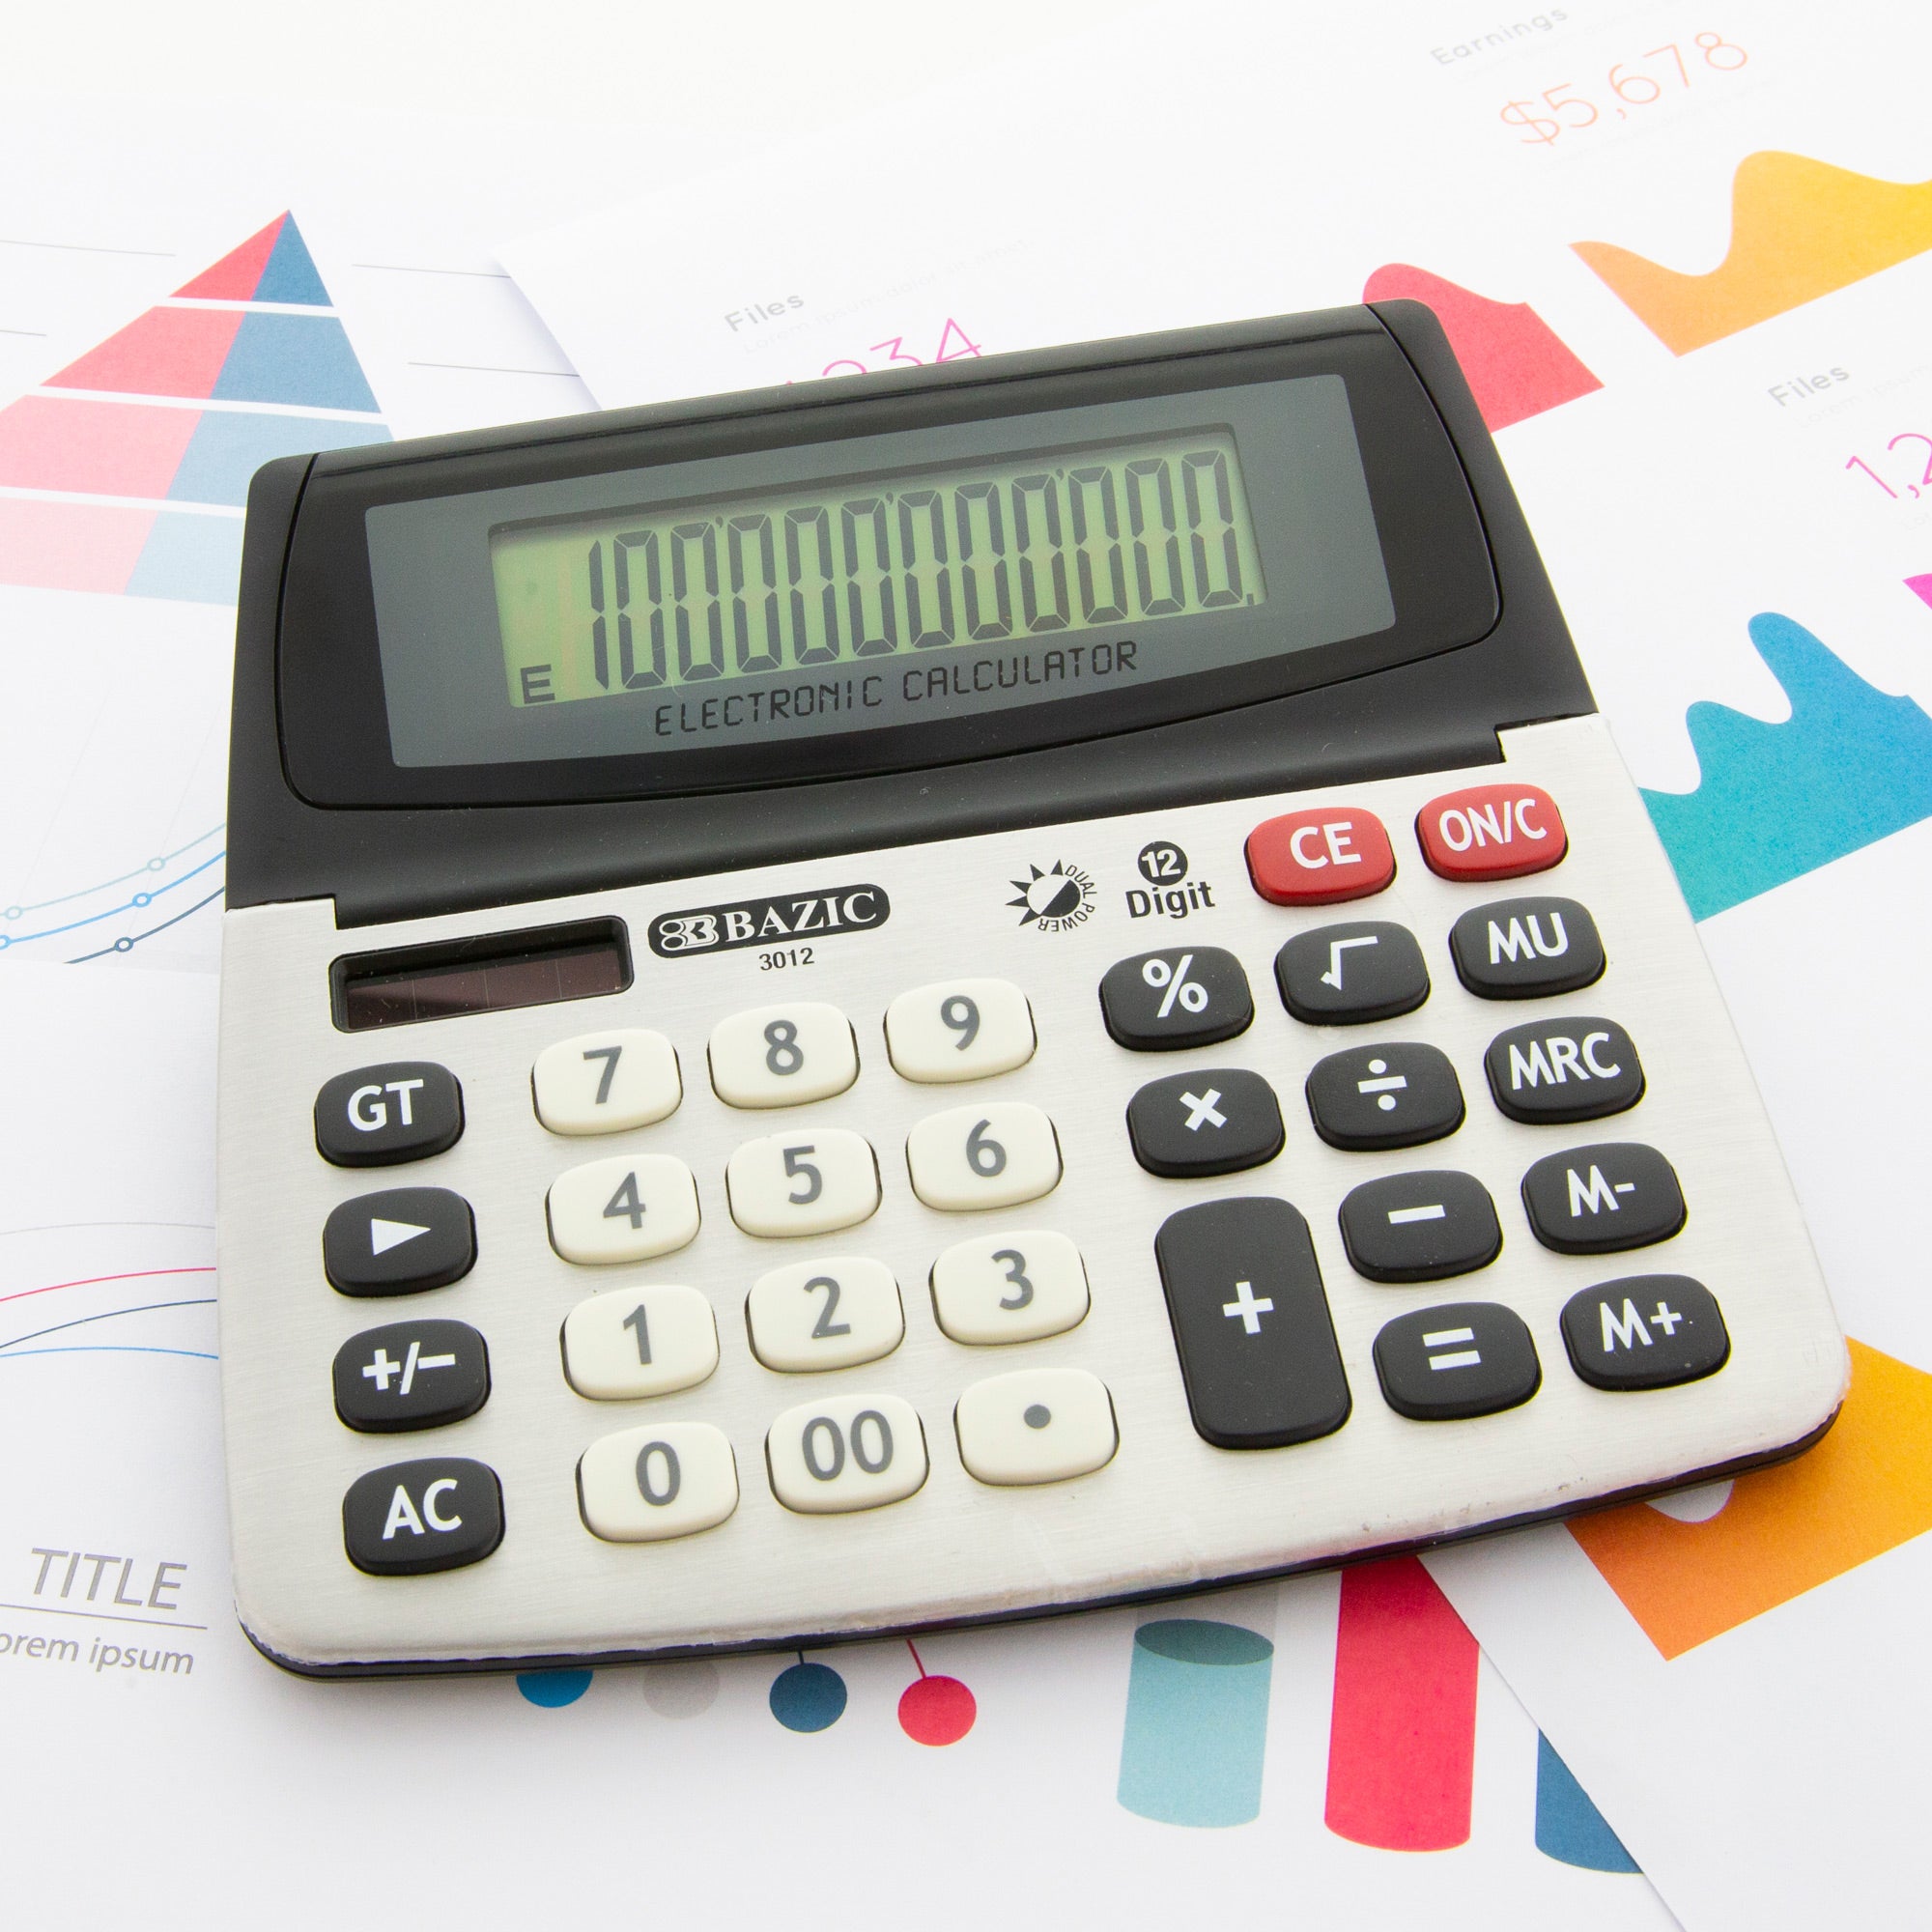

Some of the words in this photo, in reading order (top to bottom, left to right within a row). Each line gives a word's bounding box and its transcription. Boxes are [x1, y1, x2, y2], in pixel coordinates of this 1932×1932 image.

[1430, 10, 1568, 65] Earnings
[1500, 32, 1747, 145] $5,678
[724, 296, 804, 331] Files
[1768, 368, 1849, 407] Files
[521, 664, 556, 705] E
[654, 676, 883, 738] ELECTRONIC
[903, 640, 1138, 702] CALCULATOR
[1290, 822, 1361, 868] CE
[1438, 798, 1547, 852] ON/C
[1065, 864, 1097, 899] DUAL
[1141, 848, 1181, 878] 12
[722, 891, 877, 943] BAZIC
[1037, 902, 1095, 932] POWER
[1125, 881, 1215, 919] Digit
[758, 947, 814, 971] 3012
[1487, 911, 1569, 964] MU
[1142, 954, 1208, 1017] %
[764, 1020, 804, 1075] 8
[941, 996, 980, 1051] 9
[583, 1046, 622, 1104] 7
[1511, 1032, 1621, 1091] MRC
[348, 1079, 424, 1132] GT
[783, 1146, 822, 1205] 5
[966, 1120, 1007, 1178] 6
[603, 1172, 645, 1229] 4
[1567, 1165, 1635, 1217] M-
[991, 1250, 1034, 1310] 3
[623, 1305, 652, 1365] 1
[804, 1277, 851, 1339] 2
[1600, 1298, 1683, 1352] M+
[802, 1410, 894, 1481] 00
[636, 1441, 680, 1506] 0
[382, 1479, 463, 1540] AC
[31, 1548, 188, 1610] TITLE
[90, 1637, 193, 1674] ipsum
